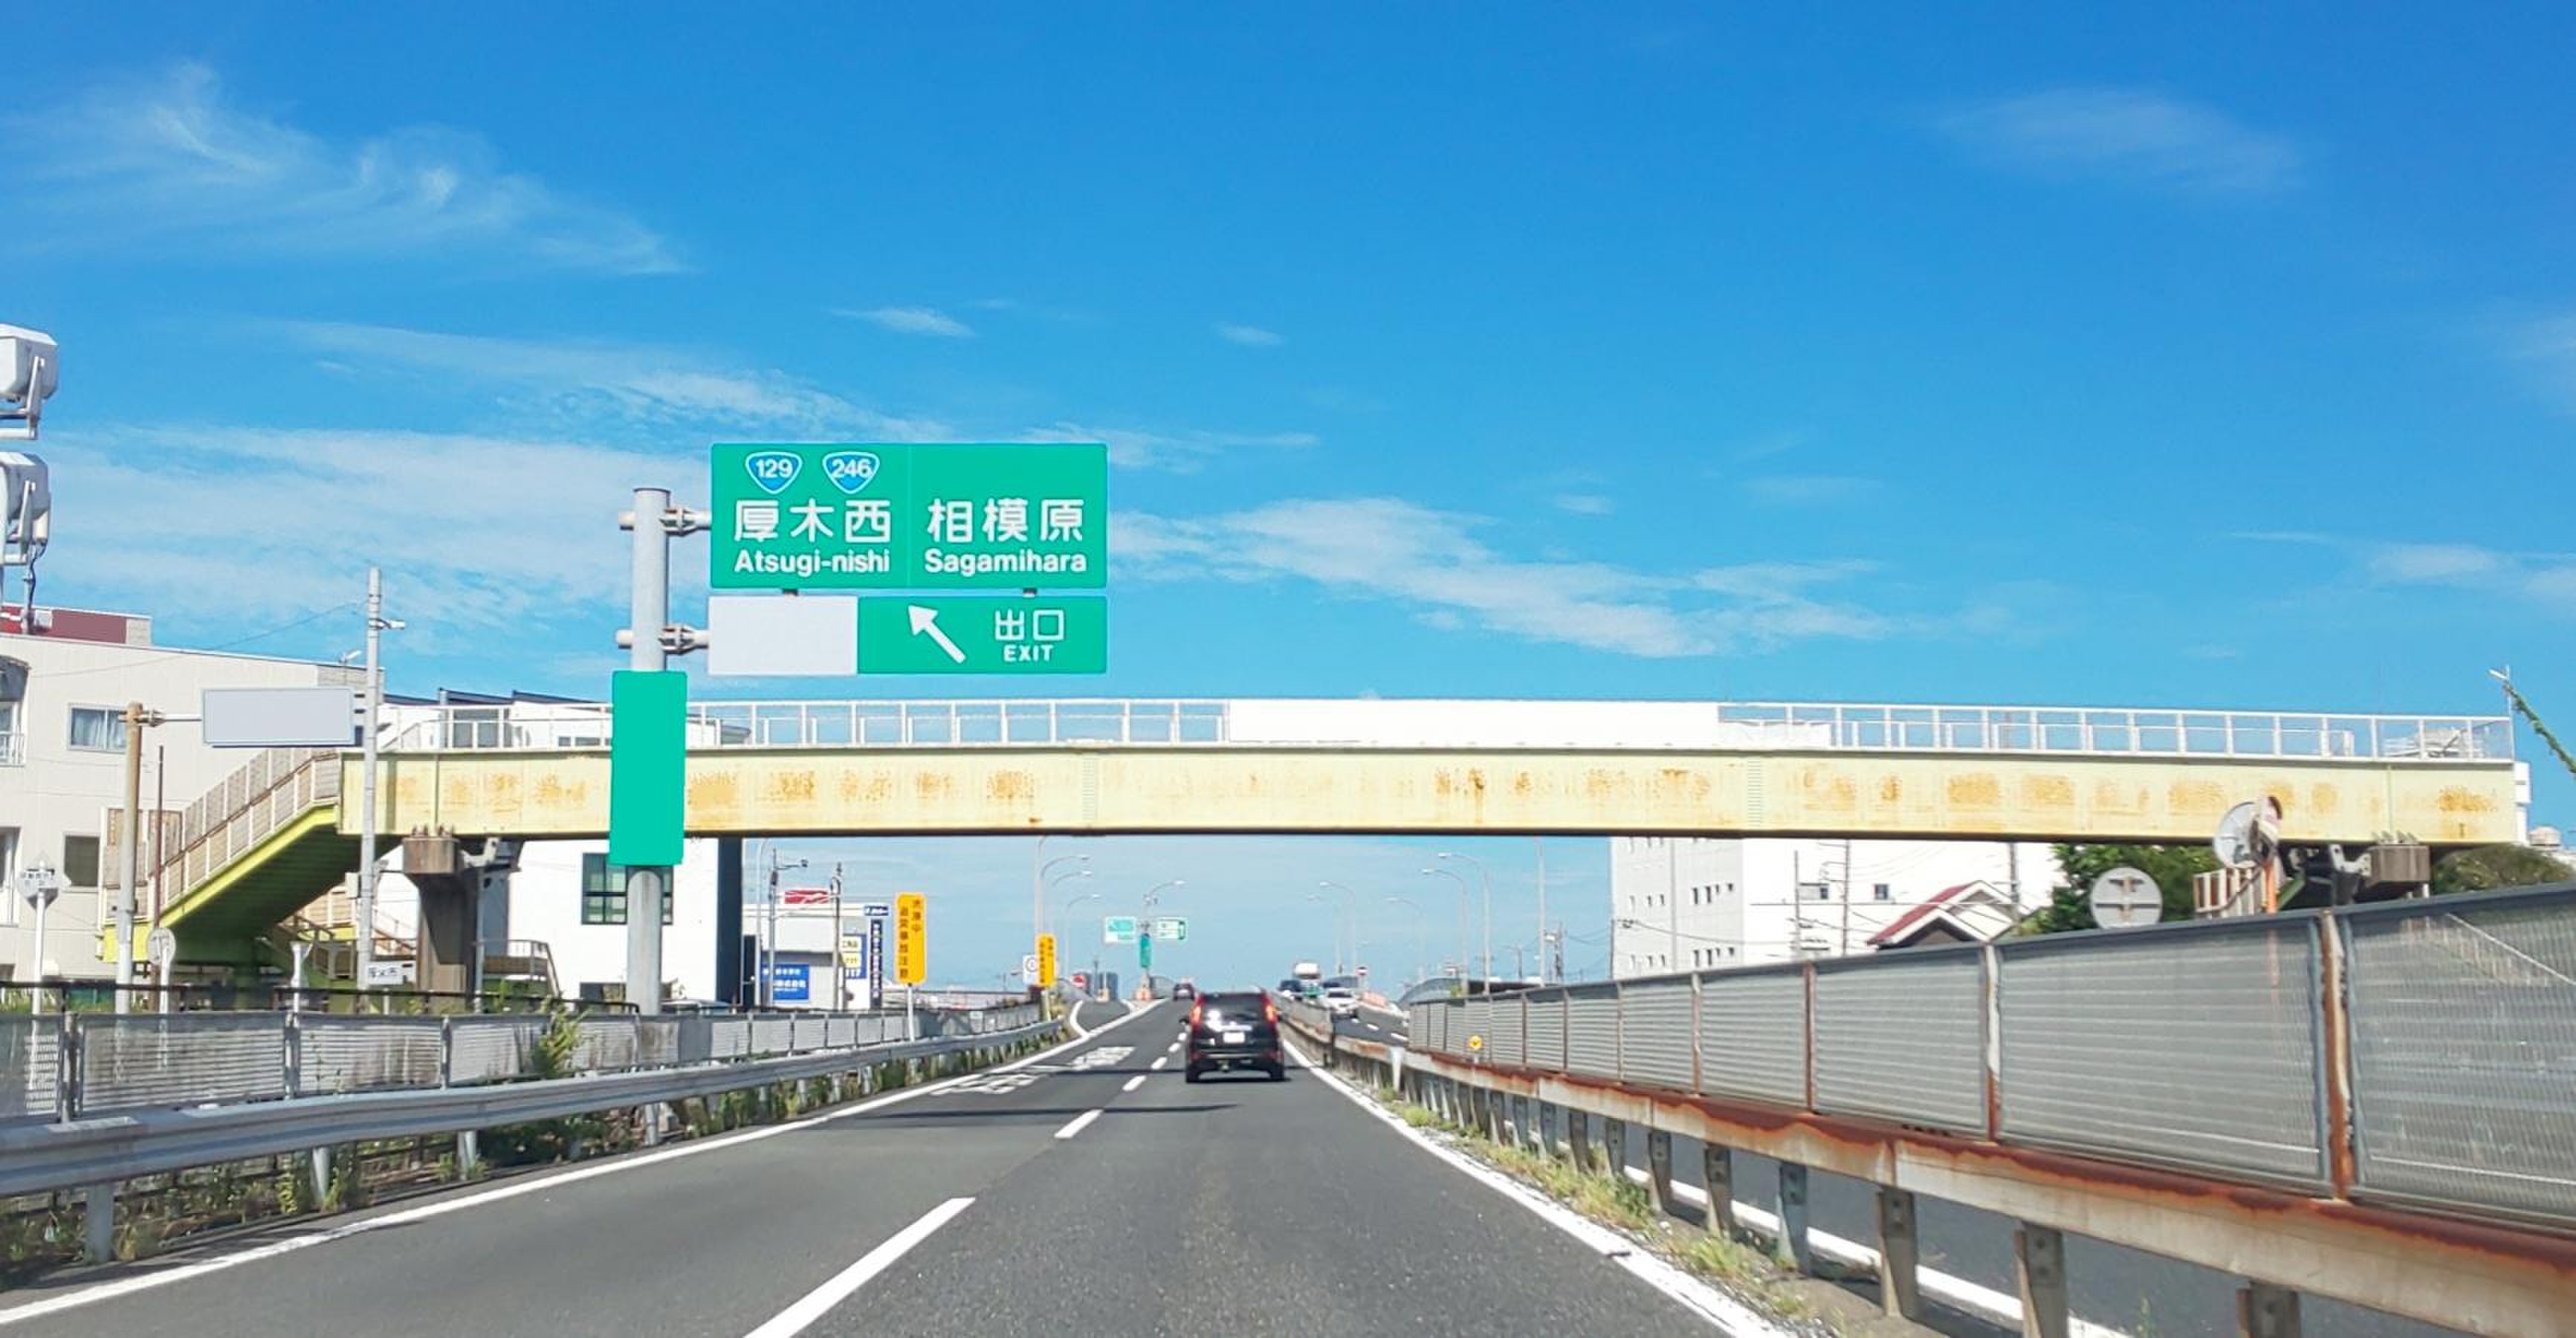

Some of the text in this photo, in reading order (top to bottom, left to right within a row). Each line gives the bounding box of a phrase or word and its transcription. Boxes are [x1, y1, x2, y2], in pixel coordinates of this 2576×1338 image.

[755, 458, 794, 478] 129
[832, 458, 873, 478] 246
[734, 497, 891, 543] 厚木西
[927, 497, 1084, 543] 相模原
[734, 549, 890, 577] Atsugi-nishi
[925, 548, 1087, 577] Sagamihara
[994, 608, 1064, 641] 出口
[1003, 644, 1054, 662] EXIT
